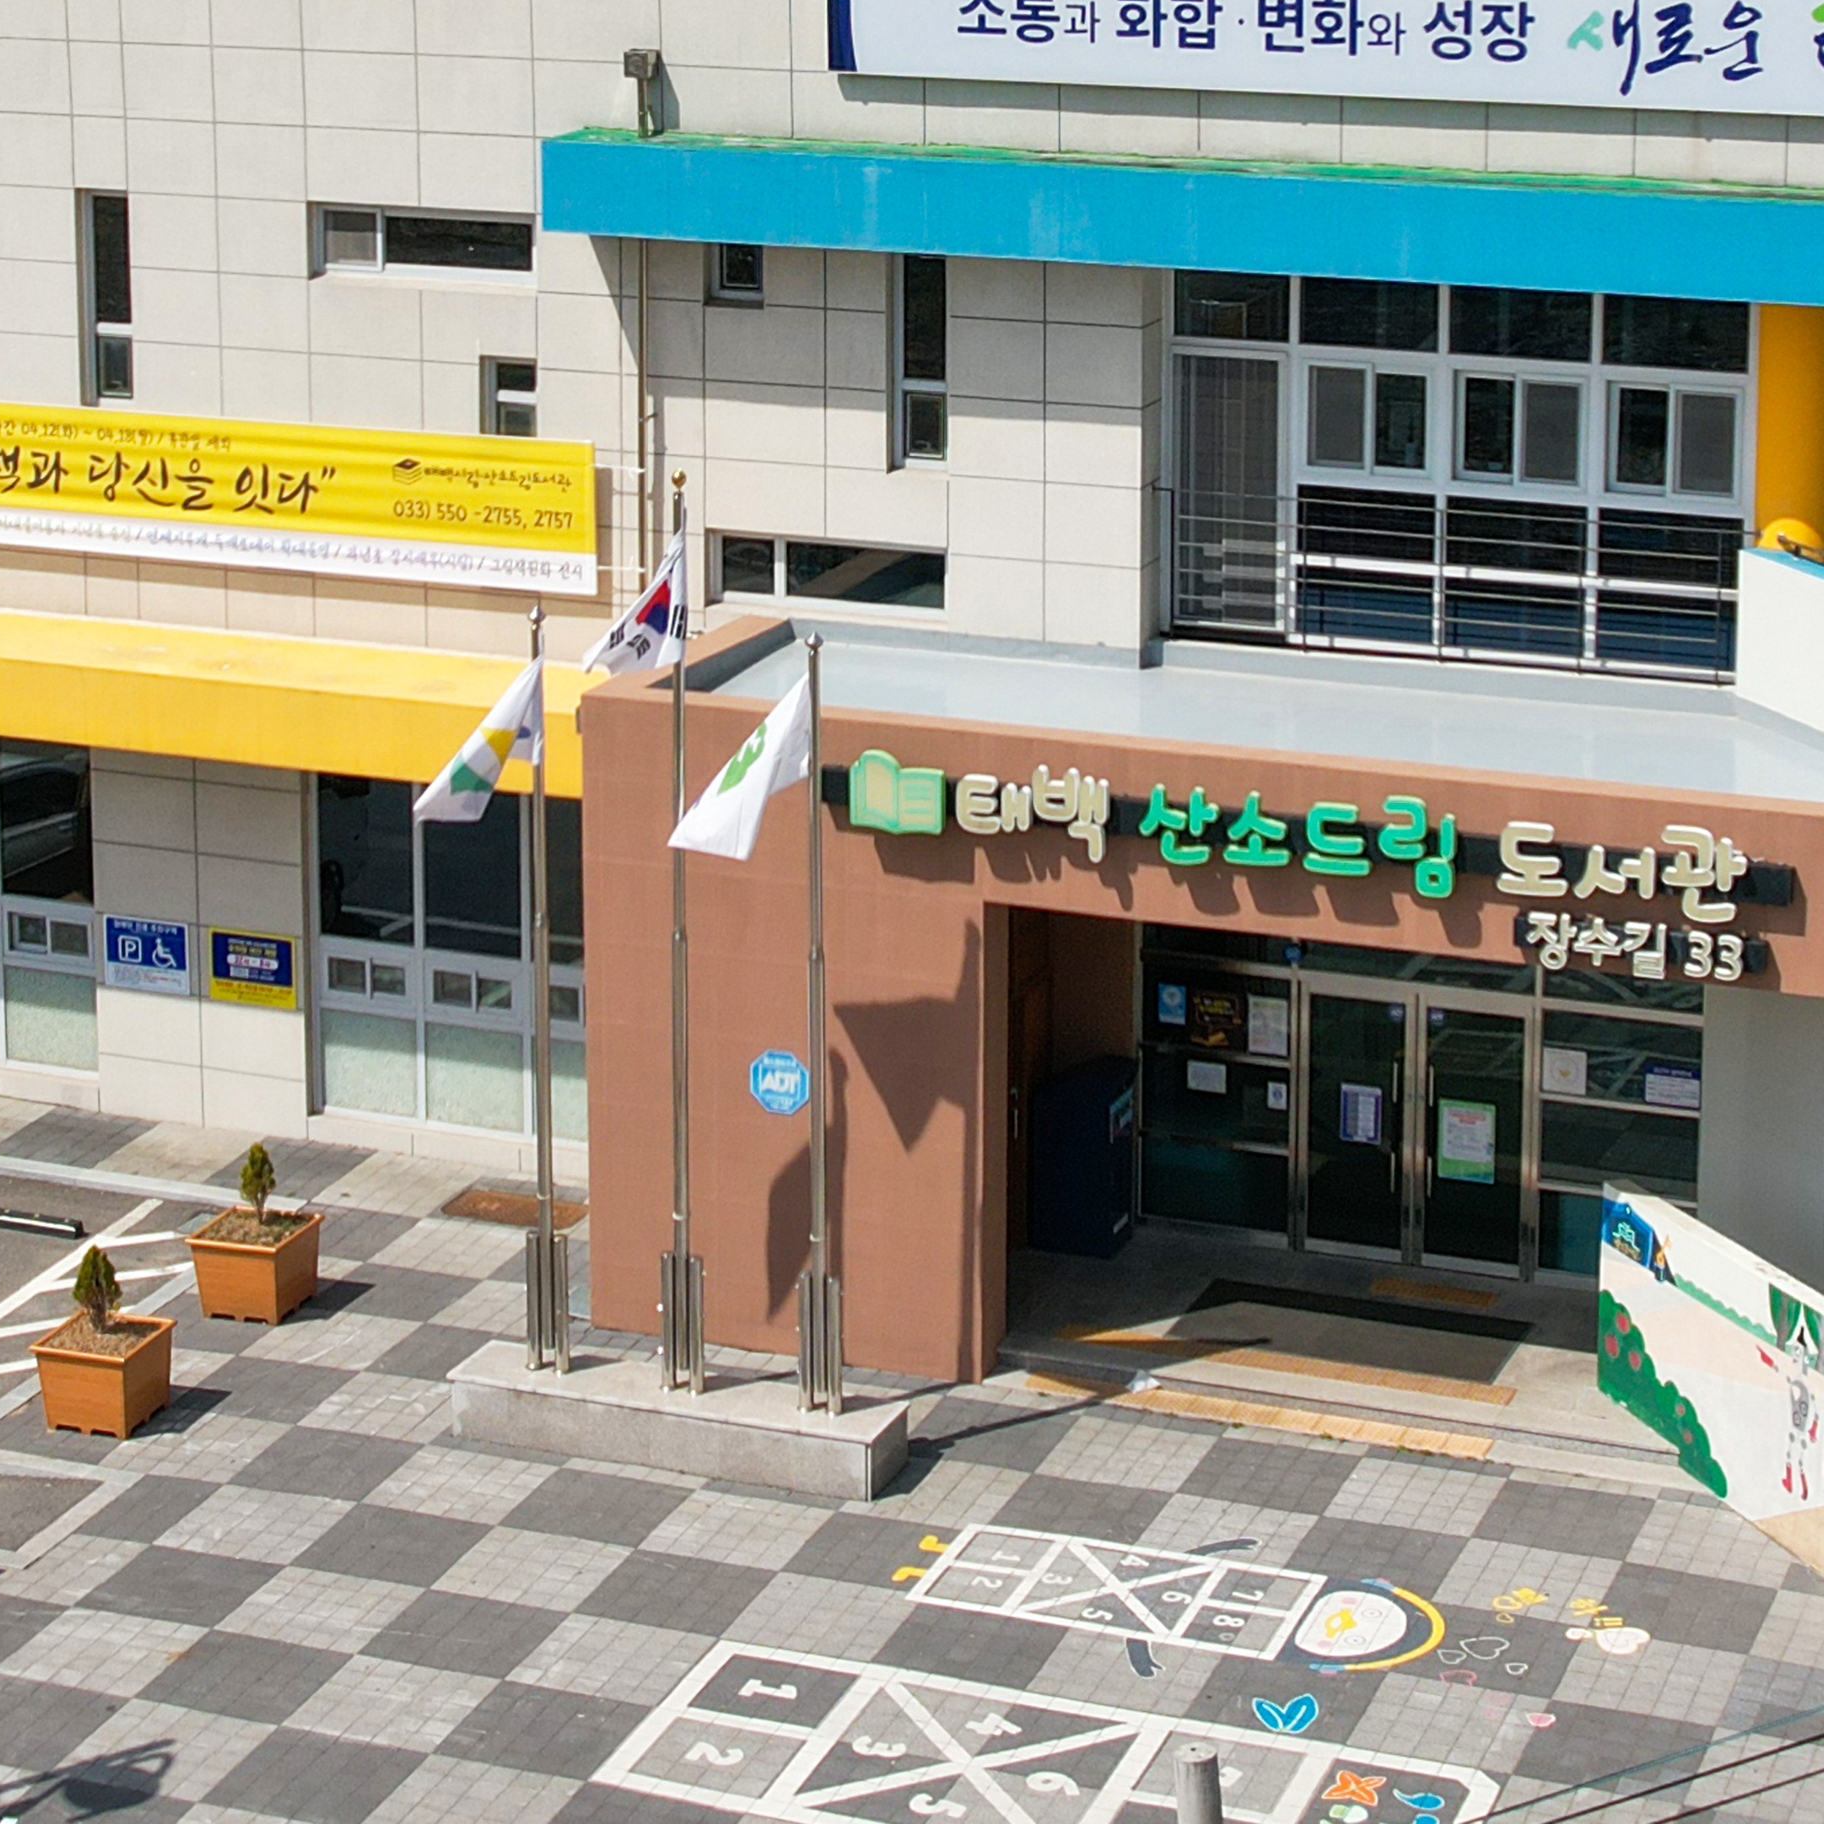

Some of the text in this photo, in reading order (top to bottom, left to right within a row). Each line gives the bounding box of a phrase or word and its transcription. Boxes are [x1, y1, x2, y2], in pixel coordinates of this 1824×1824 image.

[88, 451, 216, 511] 당신을
[393, 499, 431, 522] 033)
[437, 502, 467, 522] 550
[534, 508, 574, 530] 2757
[954, 765, 1749, 925] 태백 산소드림 도서관
[1525, 910, 1745, 981] 장수길 33
[761, 1070, 798, 1094] ADT
[738, 1678, 797, 1700] 1
[965, 1712, 1022, 1738] 4
[685, 1741, 745, 1767] 2
[851, 1735, 907, 1759] 3
[1024, 1771, 1081, 1797] 6
[908, 1792, 968, 1819] 5
